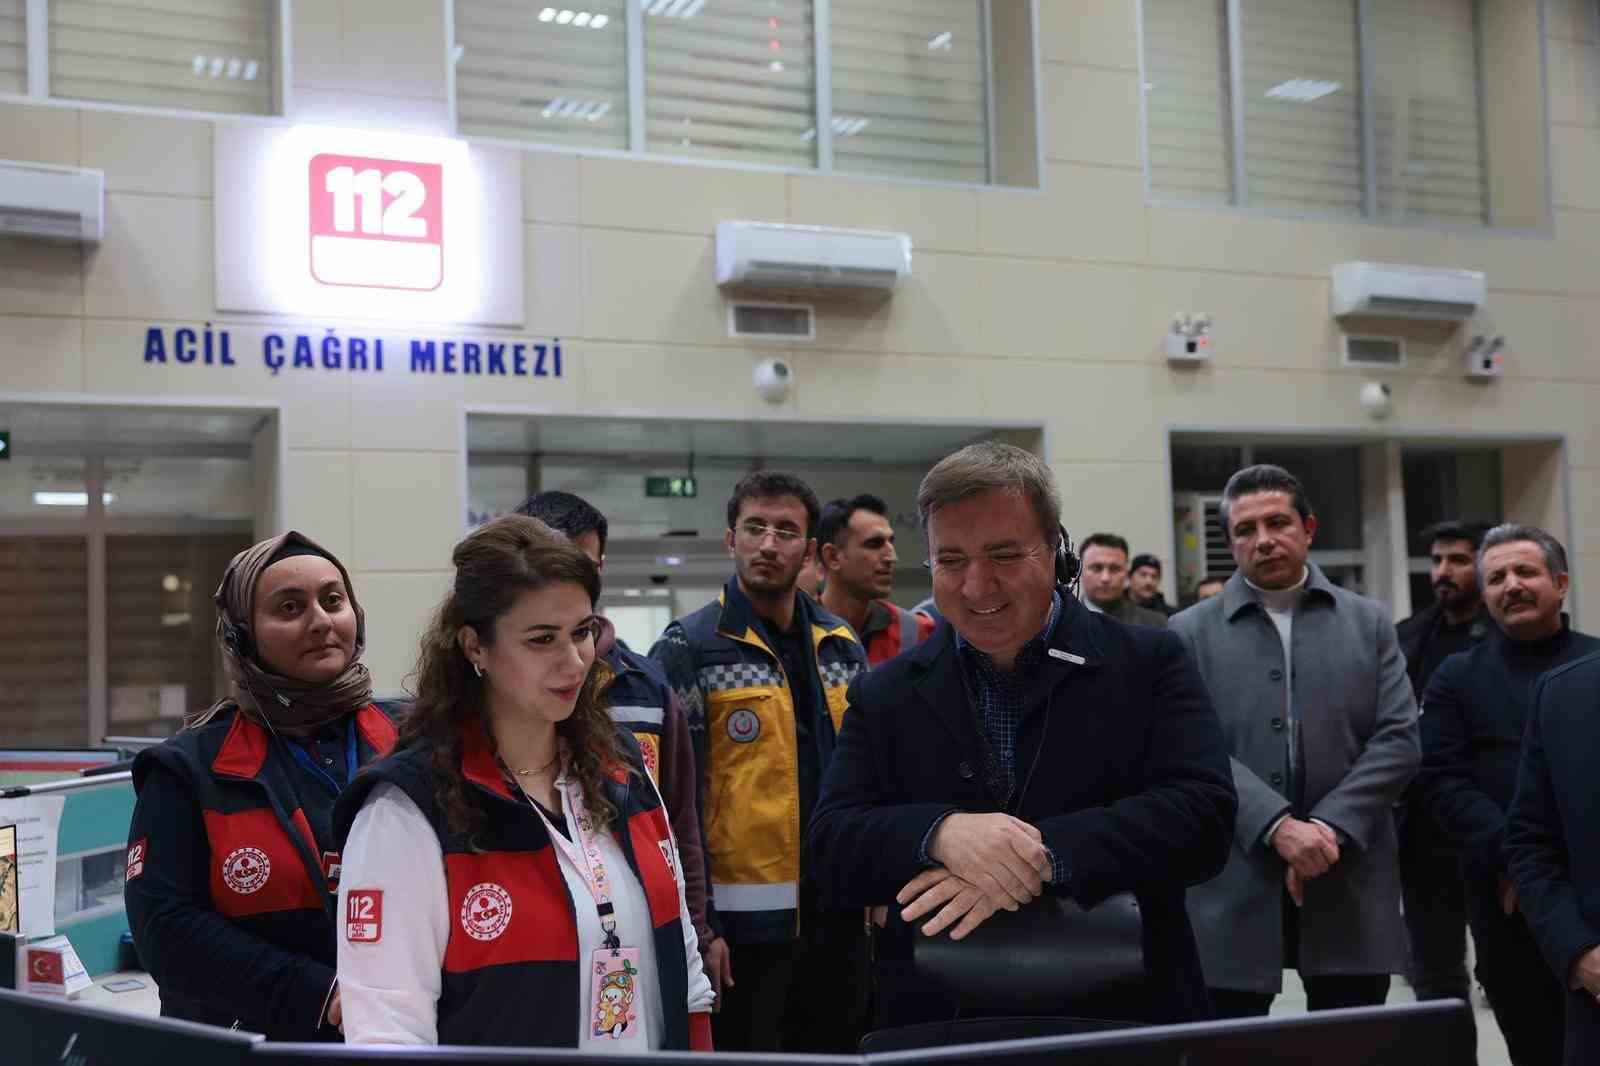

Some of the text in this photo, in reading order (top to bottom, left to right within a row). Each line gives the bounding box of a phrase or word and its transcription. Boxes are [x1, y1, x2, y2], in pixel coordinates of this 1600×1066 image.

[325, 165, 428, 238] 112
[143, 321, 563, 378] ACİL ÇAĞRI MERKEZİ
[349, 895, 375, 919] 112
